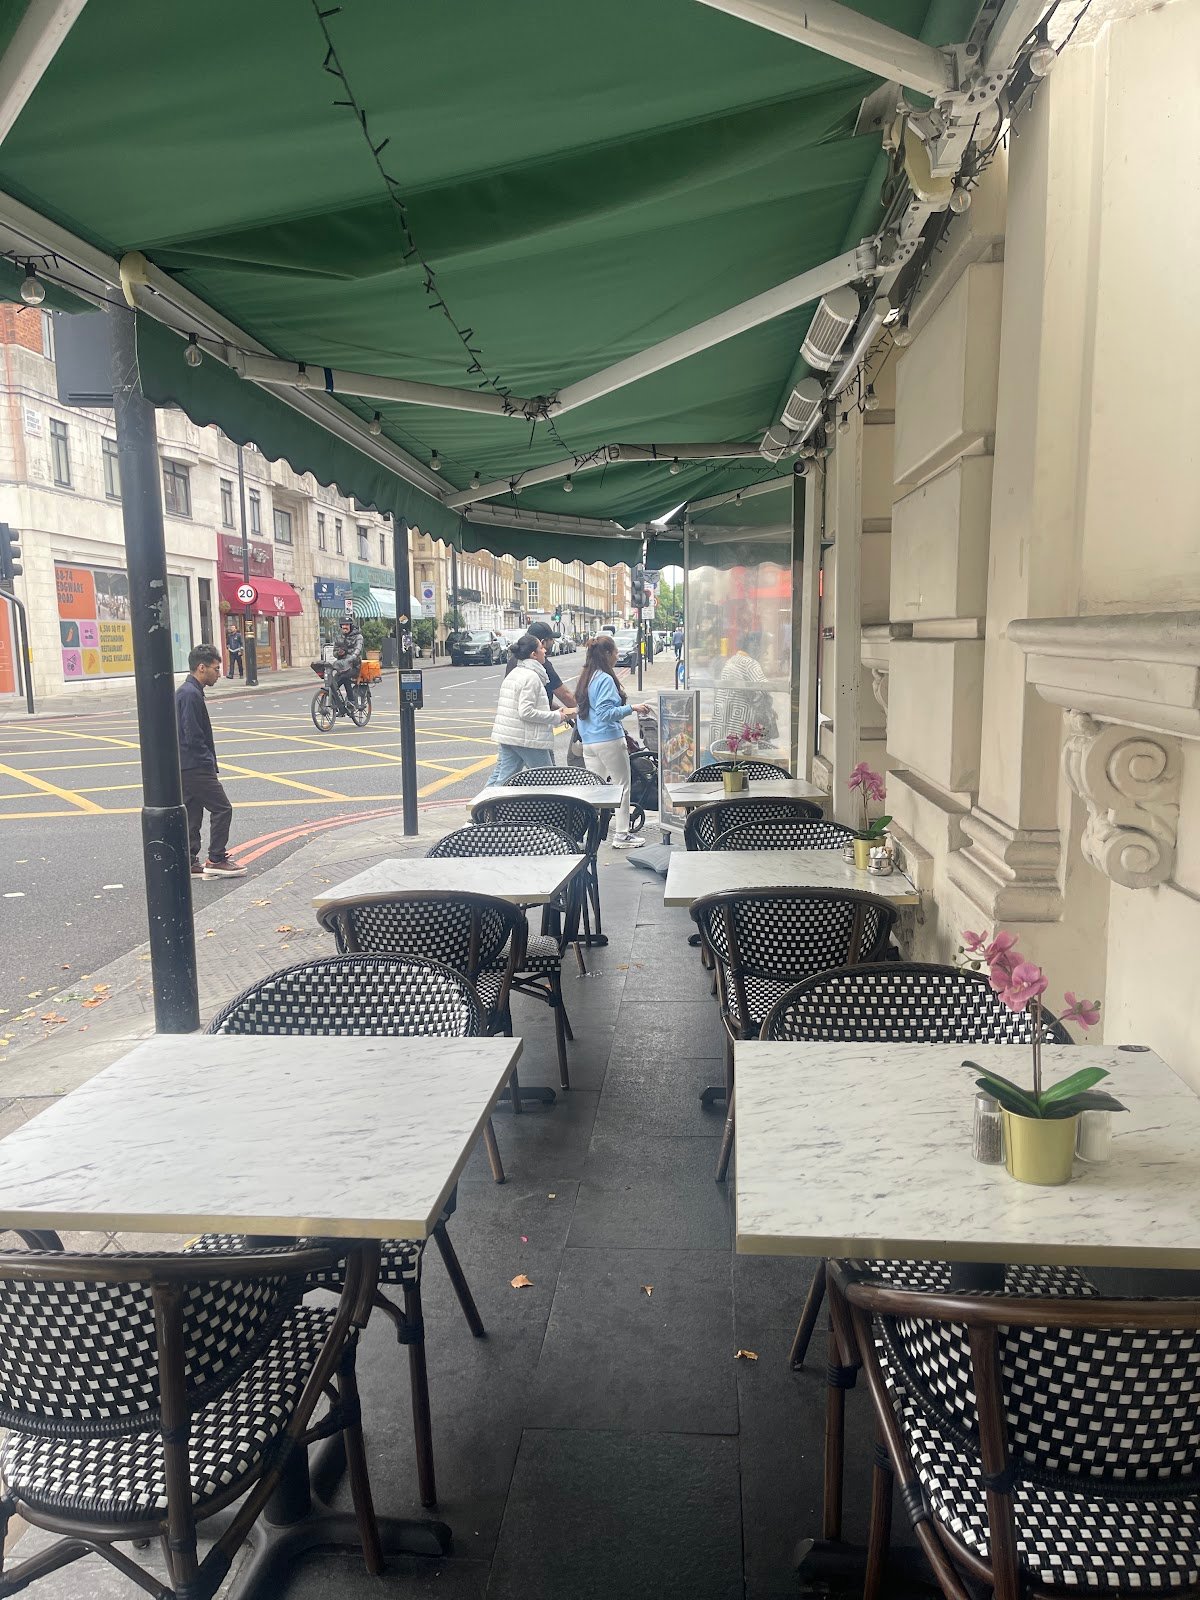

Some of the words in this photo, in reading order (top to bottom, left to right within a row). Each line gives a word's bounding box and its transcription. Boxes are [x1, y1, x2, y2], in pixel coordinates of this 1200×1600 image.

[56, 581, 83, 593] EDGWARE
[57, 593, 73, 603] ROAD
[239, 589, 253, 598] 20
